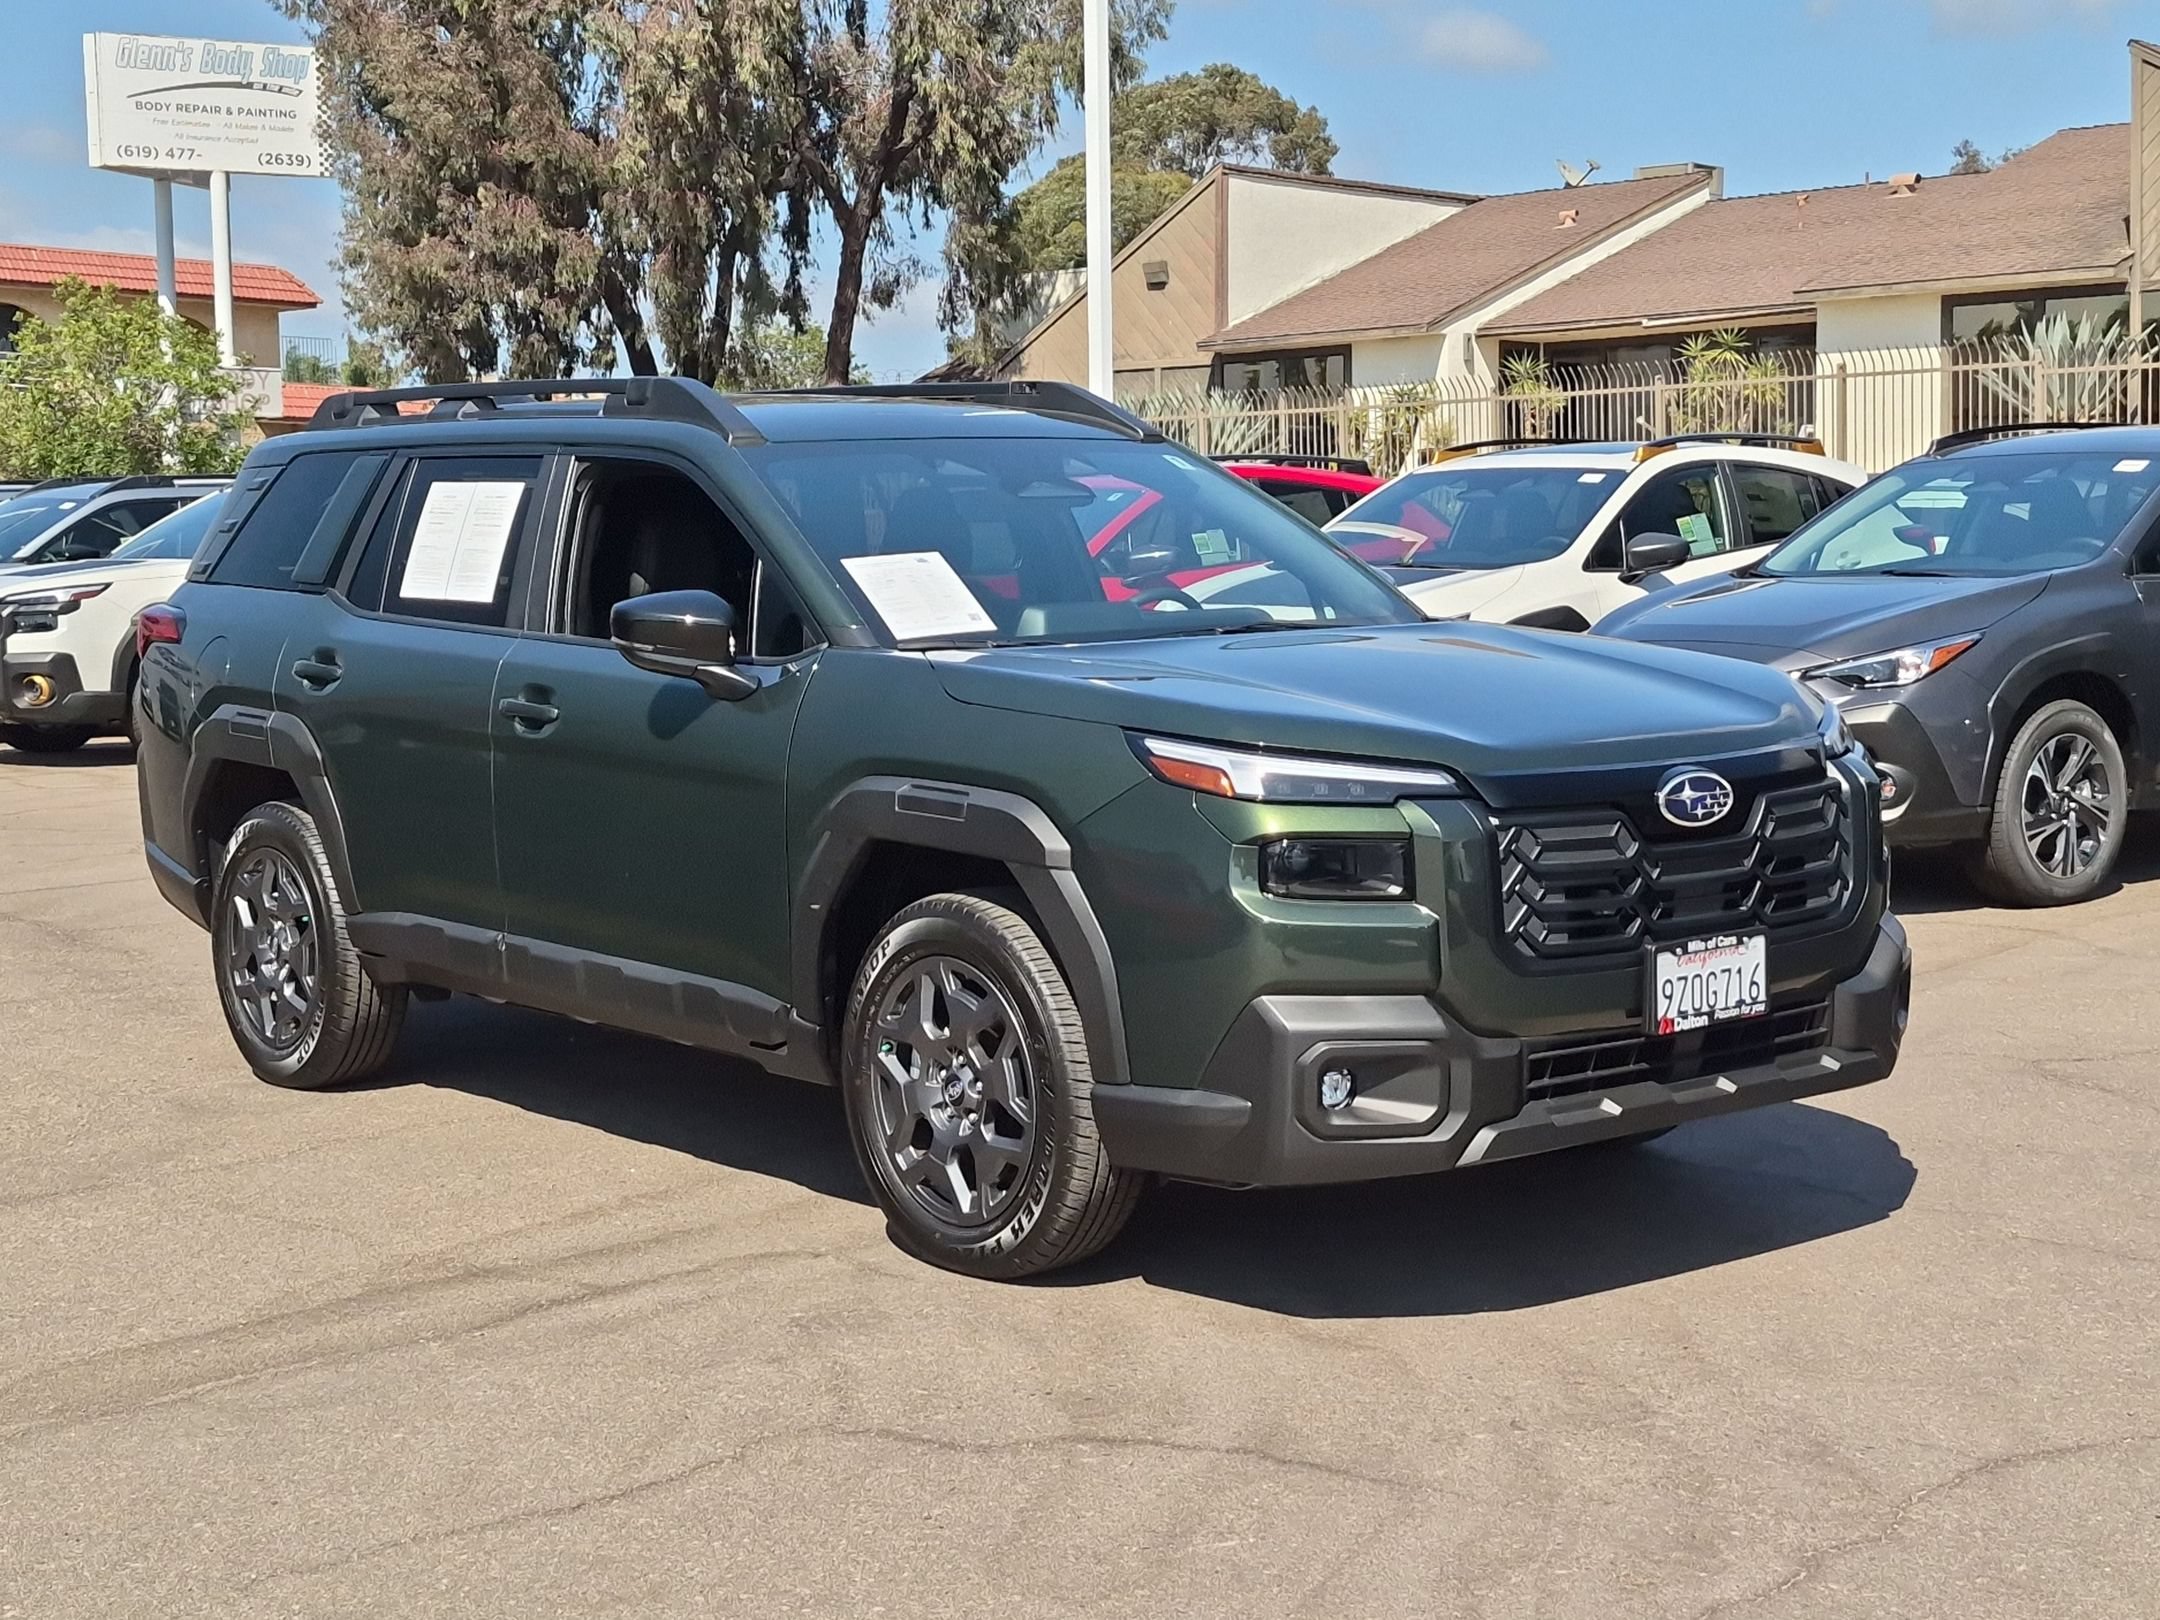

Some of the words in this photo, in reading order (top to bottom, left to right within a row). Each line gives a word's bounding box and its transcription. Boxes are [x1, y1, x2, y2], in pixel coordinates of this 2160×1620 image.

[115, 37, 193, 72] Glenn's
[199, 43, 254, 85] Body
[259, 46, 311, 85] Shop
[135, 100, 173, 112] BODY
[175, 102, 222, 116] REPAIR
[226, 106, 234, 116] &
[237, 107, 297, 120] PAINTING
[152, 117, 169, 126] Free
[171, 118, 211, 128] Estimates
[186, 133, 222, 143] Insurance
[223, 135, 259, 145] Accepted
[116, 144, 159, 161] (619)
[165, 147, 203, 161] 477-
[257, 152, 312, 168] (2639)
[1687, 940, 1706, 953] Mile
[1707, 936, 1717, 949] of
[1717, 935, 1738, 948] Cars
